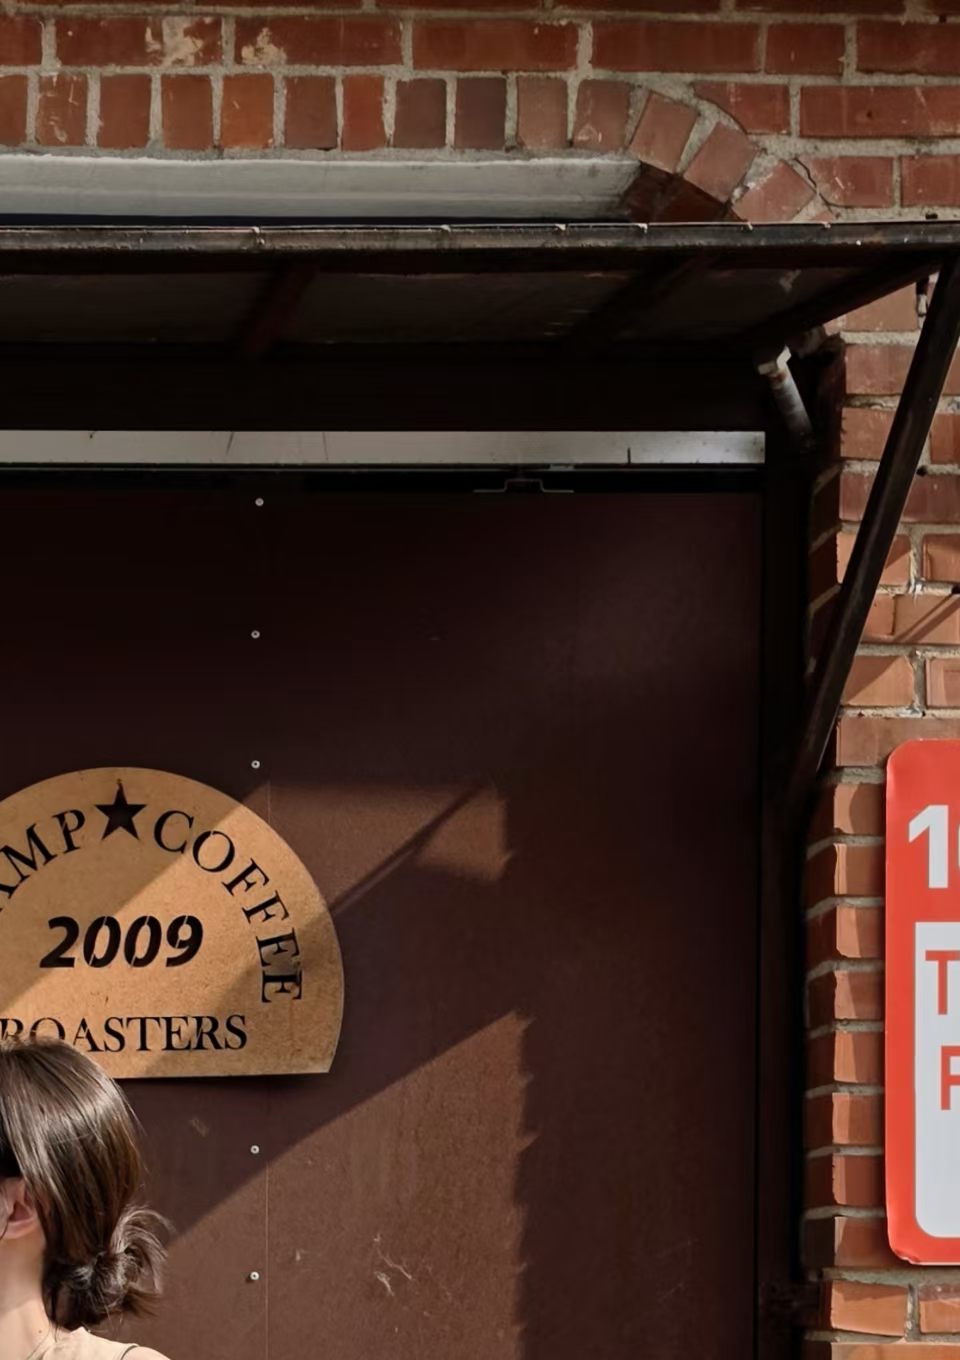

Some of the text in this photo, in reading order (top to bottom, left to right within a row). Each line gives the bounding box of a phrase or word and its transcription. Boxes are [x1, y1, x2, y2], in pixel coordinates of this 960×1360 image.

[908, 804, 960, 889] 1
[40, 916, 204, 968] 2009
[154, 810, 303, 1003] COFFEE
